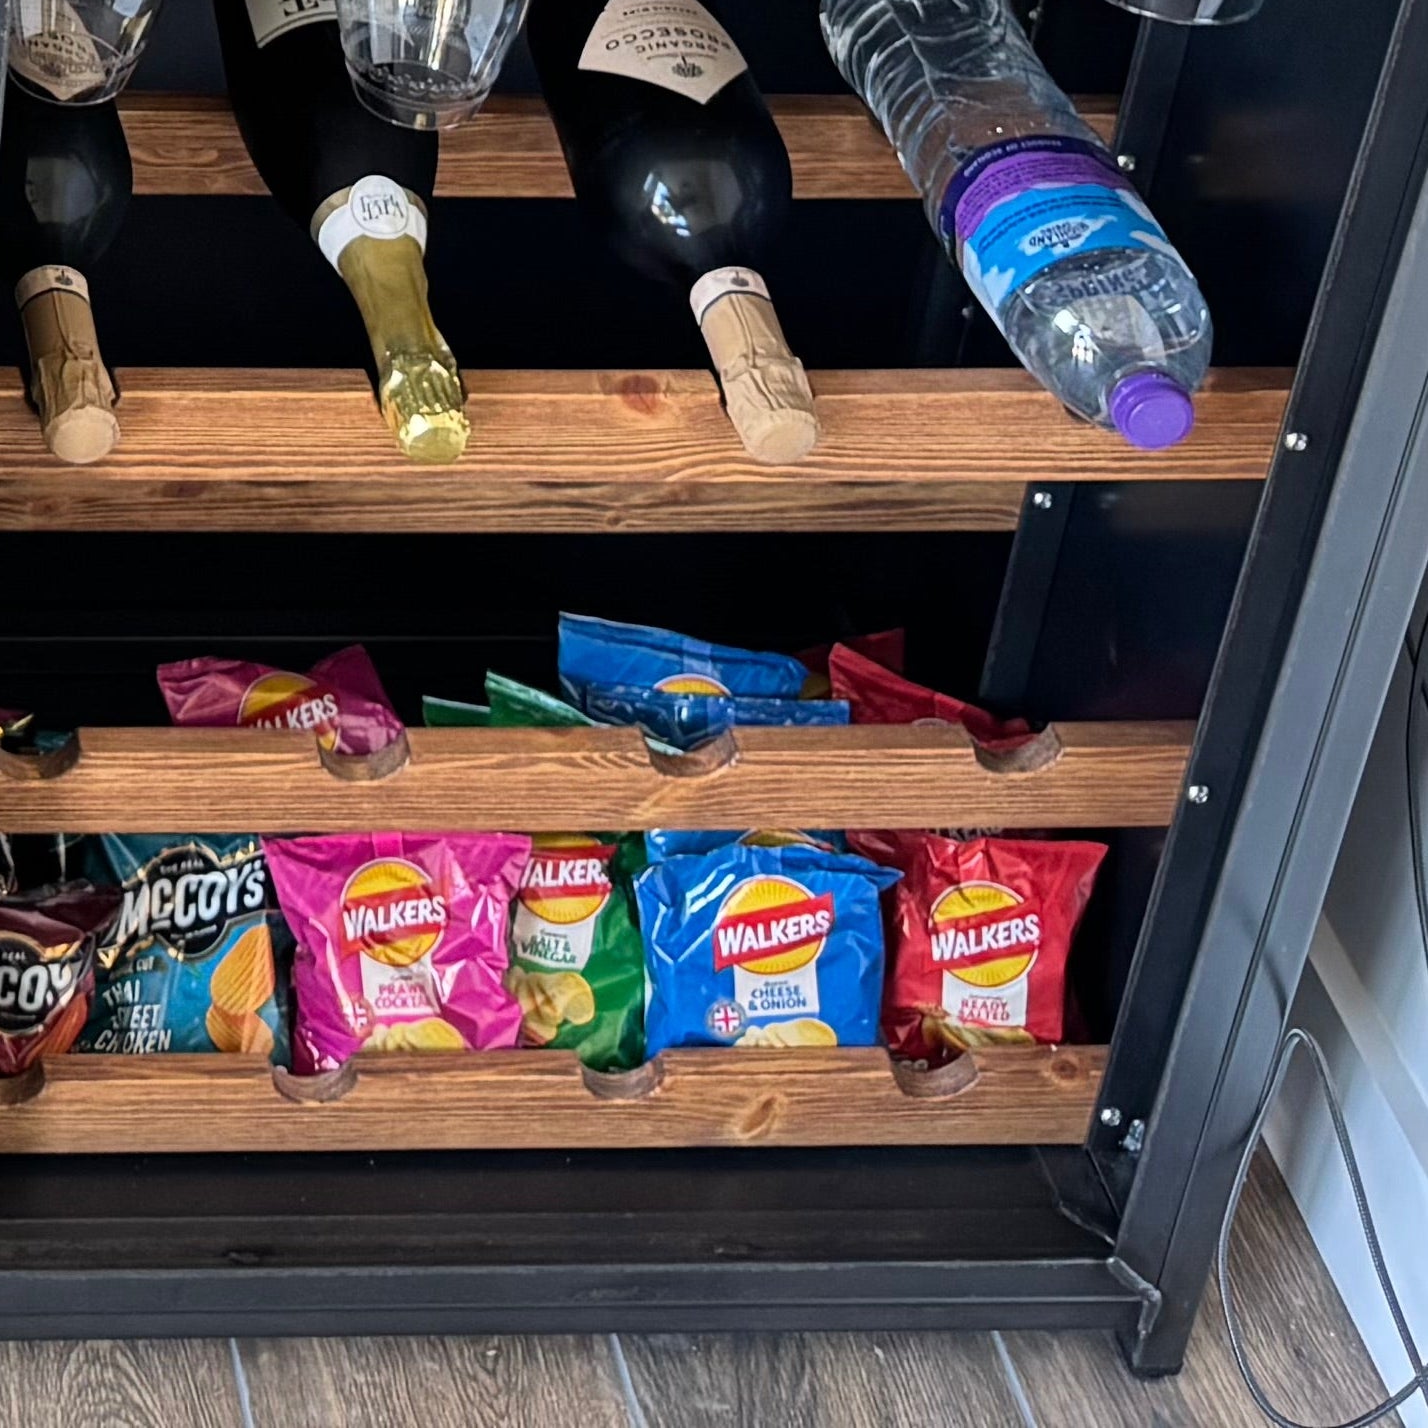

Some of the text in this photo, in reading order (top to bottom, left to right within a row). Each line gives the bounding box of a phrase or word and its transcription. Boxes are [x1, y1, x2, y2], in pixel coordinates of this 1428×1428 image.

[633, 38, 719, 57] ORGANIC
[343, 895, 446, 942] WALKERS
[717, 909, 831, 957] WALKERS
[930, 913, 1041, 962] WALKERS
[520, 942, 578, 966] VINEGAR
[101, 979, 141, 1010] THAI
[747, 996, 808, 1013] & ONION
[750, 984, 803, 999] CHEESE
